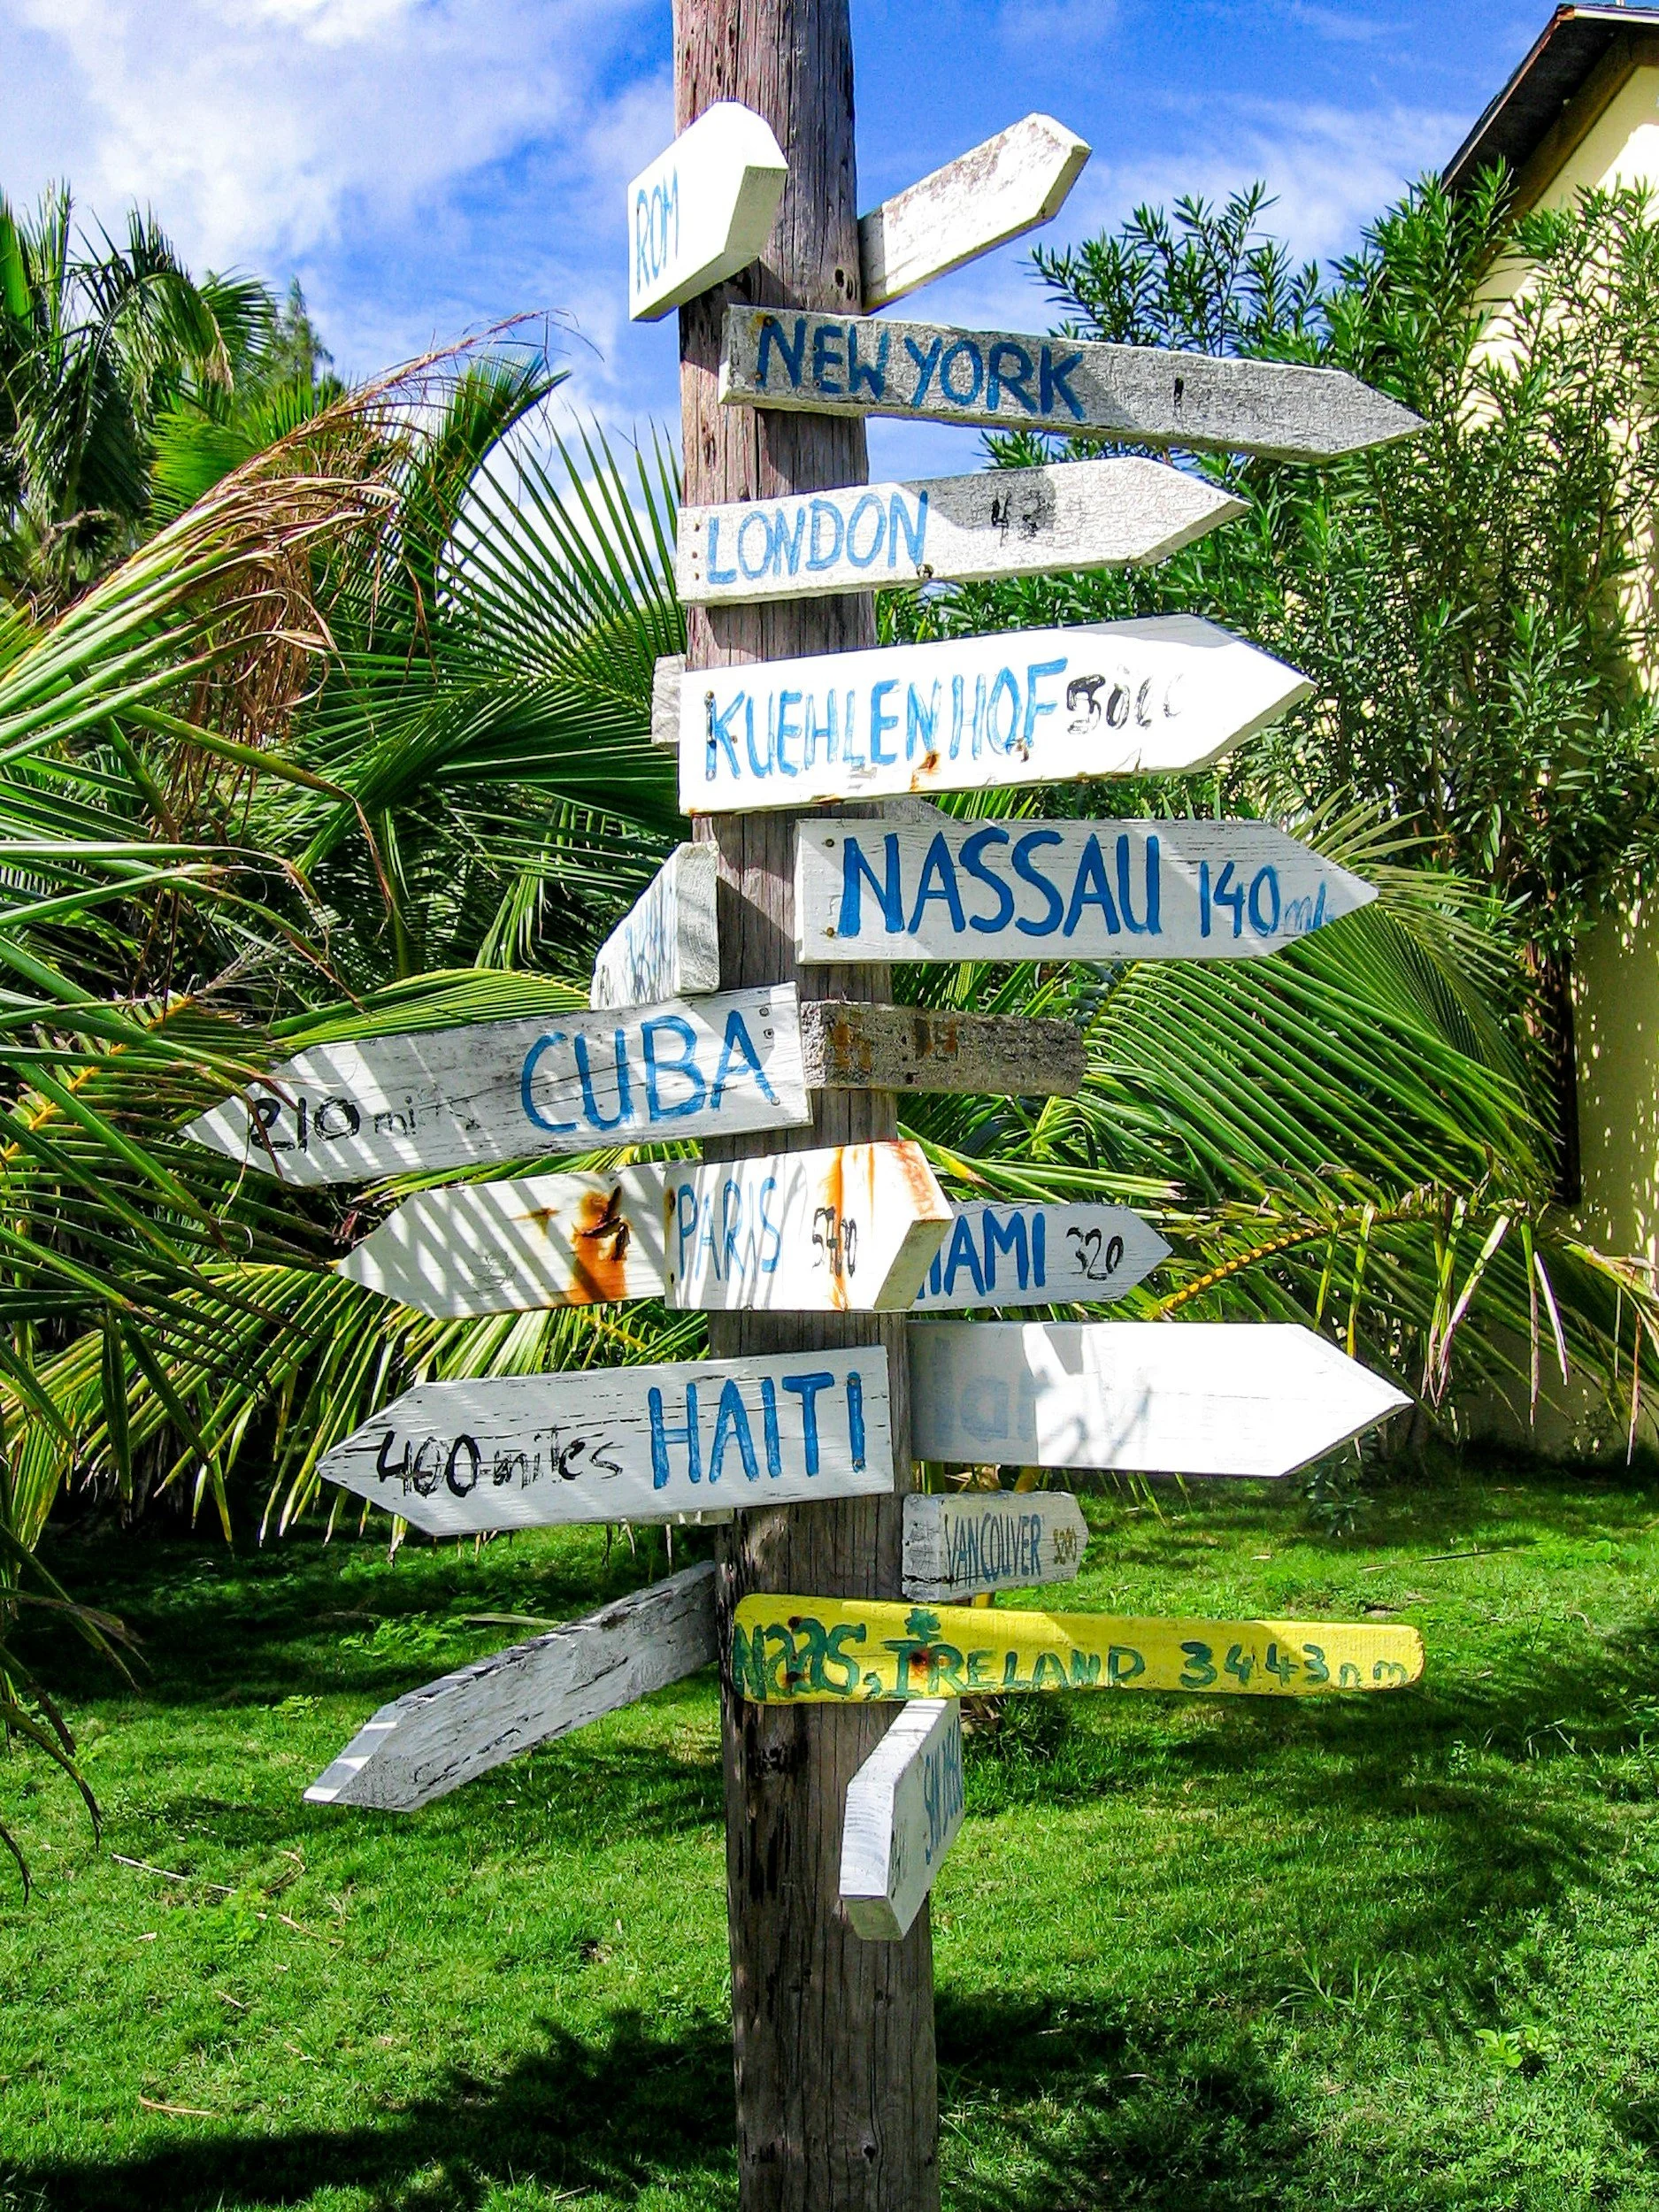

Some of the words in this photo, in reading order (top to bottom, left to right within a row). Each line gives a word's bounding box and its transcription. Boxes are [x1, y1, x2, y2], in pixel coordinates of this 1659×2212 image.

[635, 166, 679, 294] ROM
[757, 317, 887, 401] NEW
[904, 335, 1086, 421] YORK
[708, 490, 929, 585] LONDON
[706, 657, 1068, 780] KUEHLENHOF
[838, 826, 1162, 938] NASSAU
[1200, 860, 1280, 939] 140
[251, 1097, 360, 1152] 210
[521, 1010, 780, 1133] CUBA
[678, 1178, 782, 1282] PARIS
[917, 1208, 1047, 1300] IAMI
[1065, 1226, 1125, 1281] 320
[376, 1429, 481, 1498] 400
[492, 1425, 623, 1490] miles
[649, 1371, 866, 1490] HAITI
[945, 1512, 1042, 1590] VANCOUVER
[880, 1639, 1146, 1699] IRELAND
[1179, 1641, 1330, 1689] 3443
